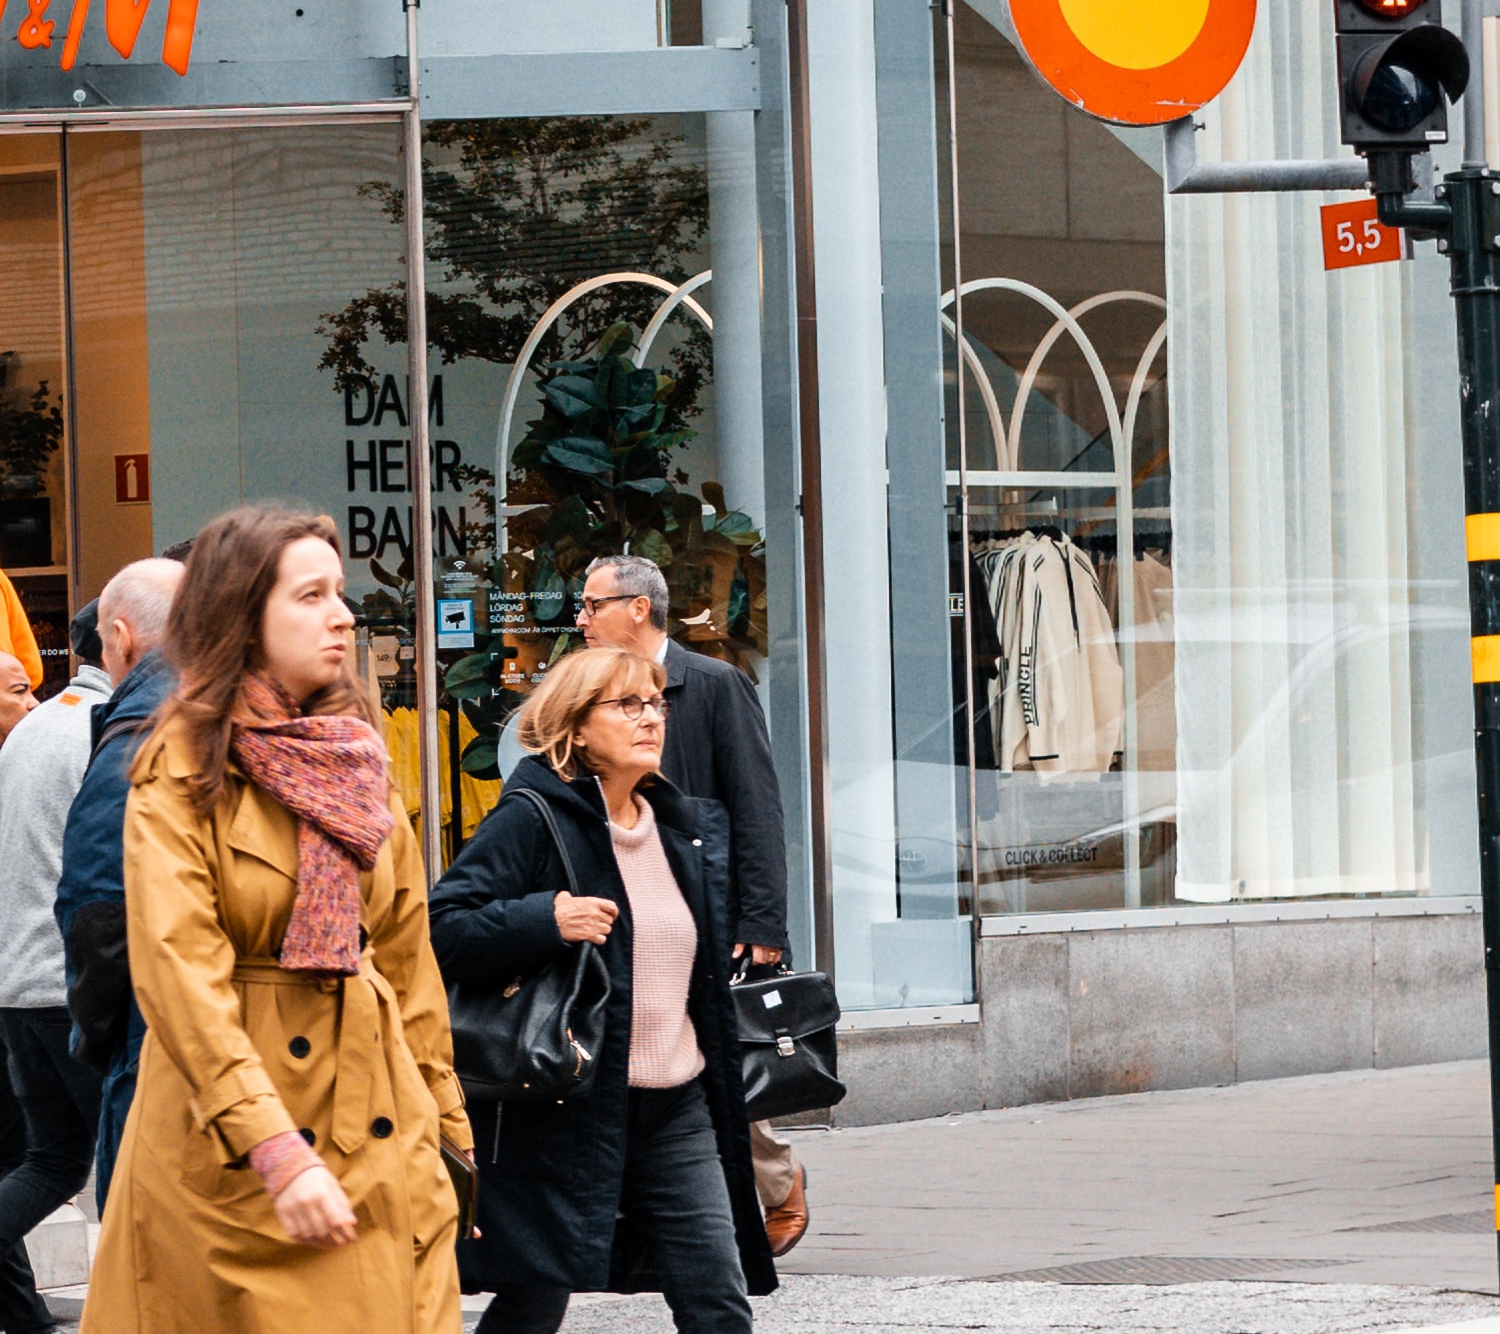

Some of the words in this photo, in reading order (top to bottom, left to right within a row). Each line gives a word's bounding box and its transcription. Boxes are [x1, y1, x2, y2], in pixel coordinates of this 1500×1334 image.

[1336, 218, 1381, 256] 5,5
[1004, 849, 1036, 866] CLICK
[1049, 846, 1098, 863] COLLECT
